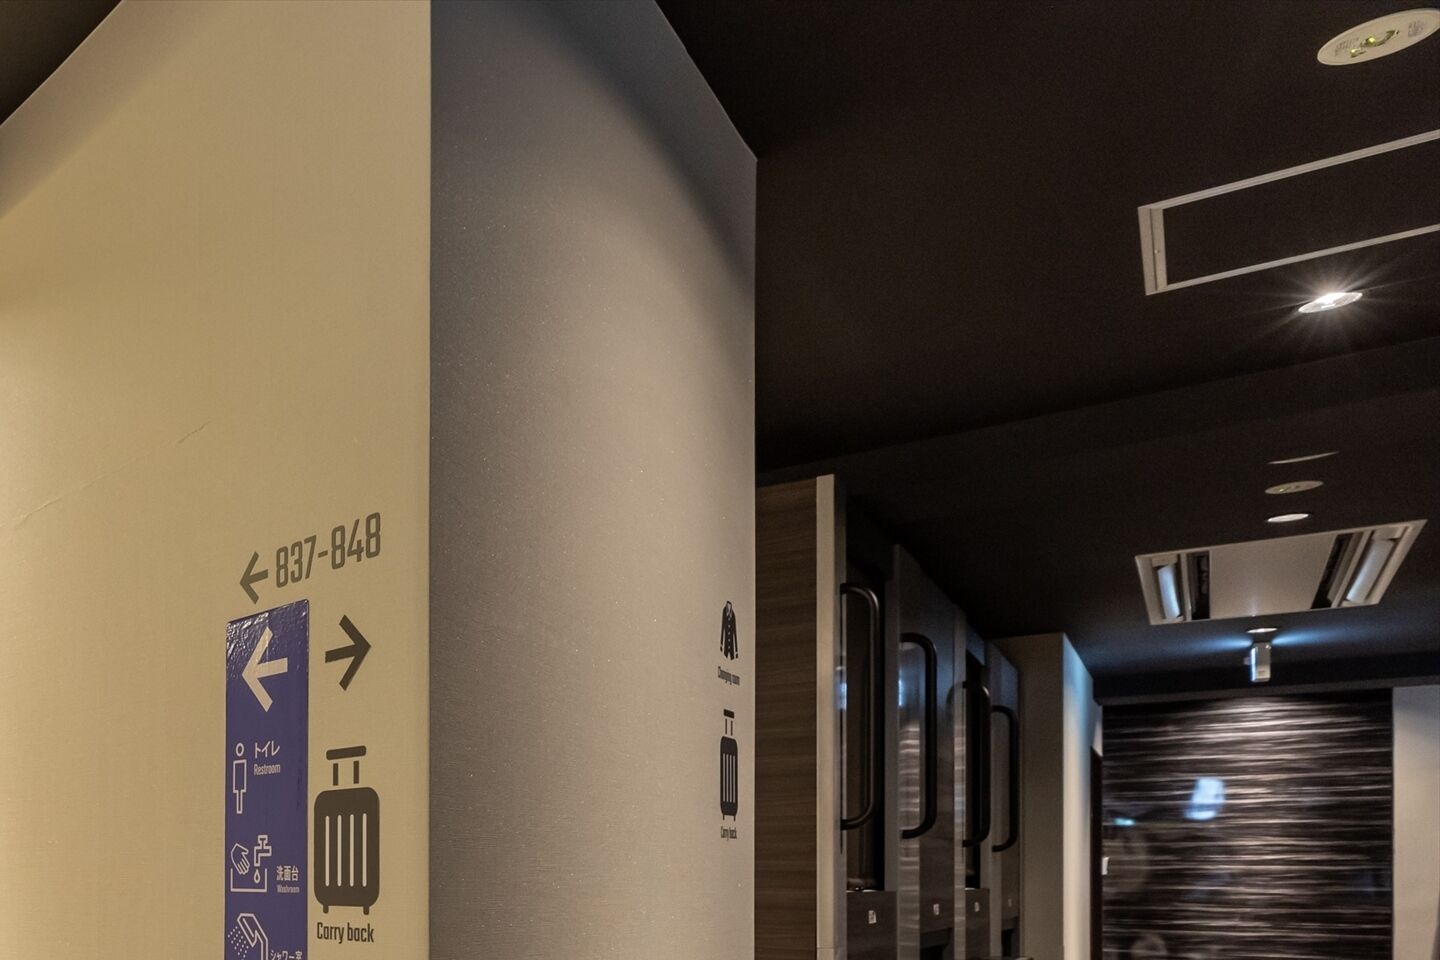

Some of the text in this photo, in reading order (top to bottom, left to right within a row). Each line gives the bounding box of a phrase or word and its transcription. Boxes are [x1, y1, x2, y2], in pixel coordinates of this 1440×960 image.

[275, 511, 381, 589] 837-848
[254, 740, 281, 759] トイレ
[253, 763, 281, 776] Restroom
[276, 864, 299, 882] 洗面台
[316, 921, 375, 945] Carry back
